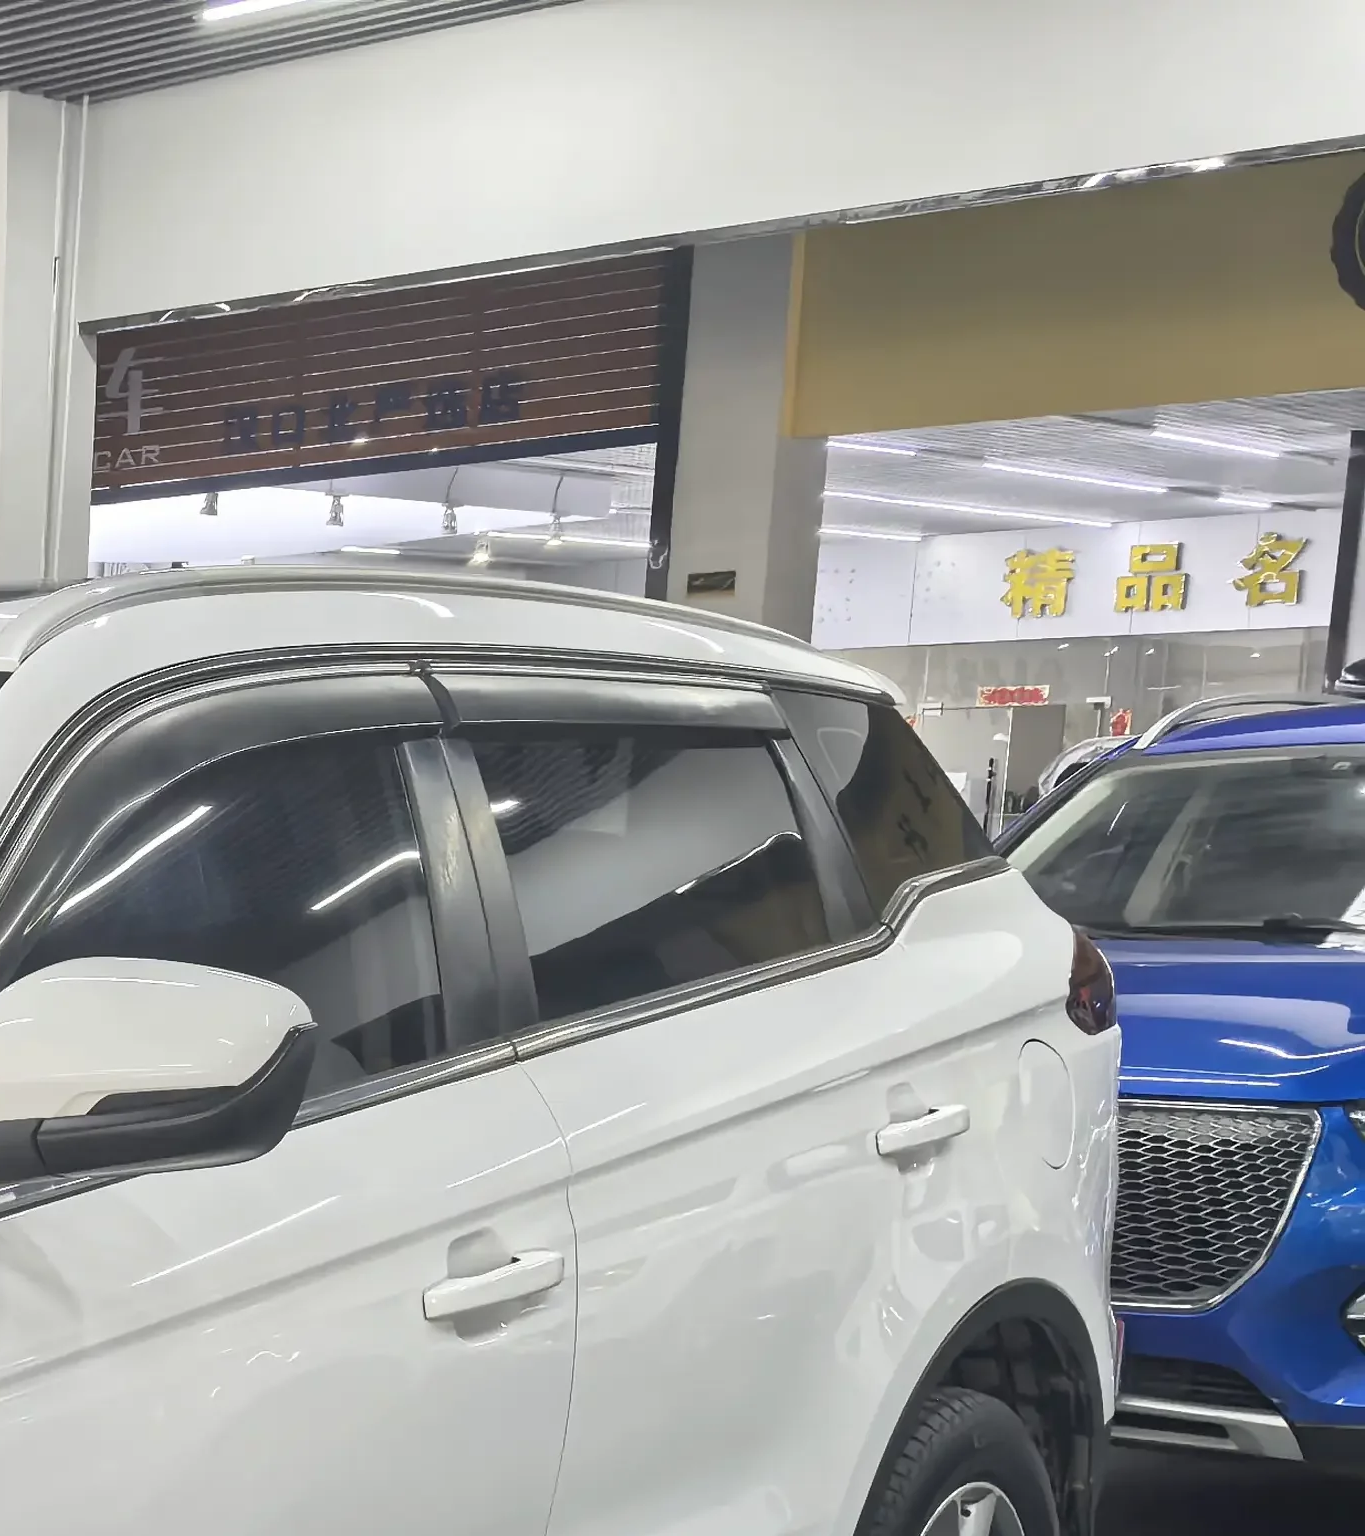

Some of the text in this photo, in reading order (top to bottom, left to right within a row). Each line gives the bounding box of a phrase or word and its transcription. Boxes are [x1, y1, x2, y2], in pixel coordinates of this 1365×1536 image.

[93, 443, 162, 473] CAR
[998, 530, 1311, 620] 精品名
